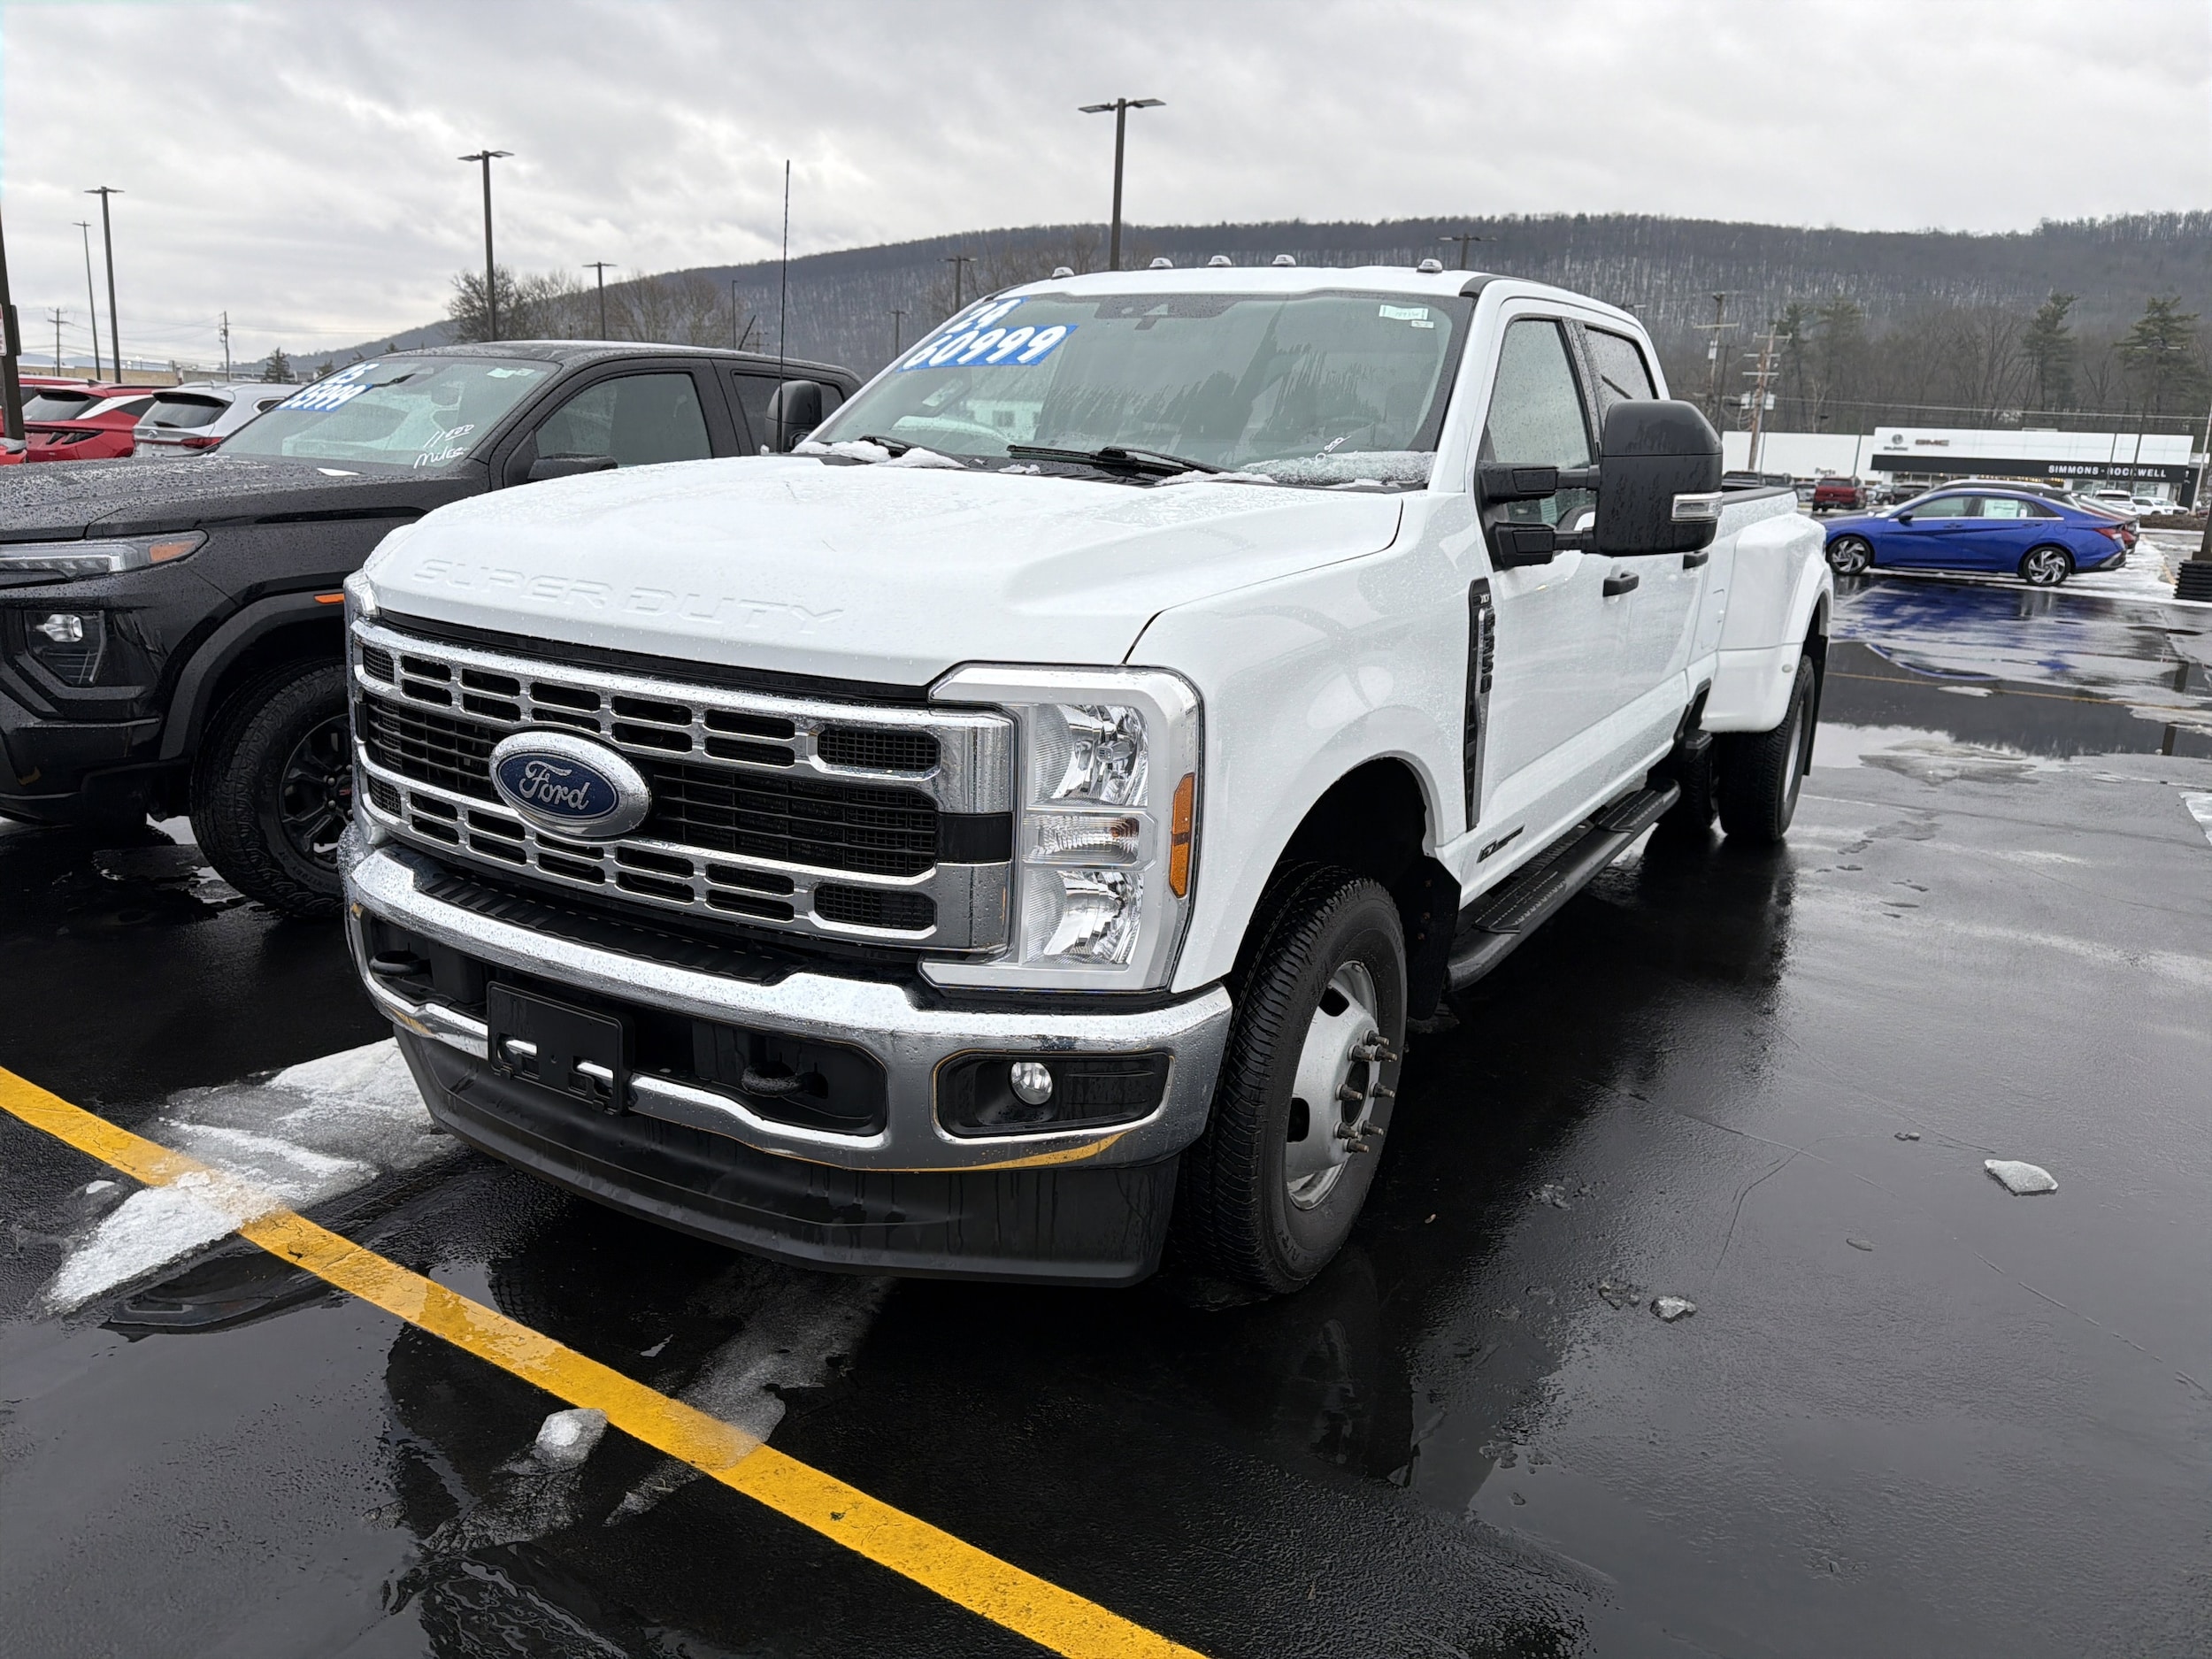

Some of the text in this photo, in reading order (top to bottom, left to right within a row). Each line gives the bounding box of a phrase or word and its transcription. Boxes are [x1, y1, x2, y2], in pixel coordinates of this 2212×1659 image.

[902, 325, 1067, 371] 60999
[411, 558, 845, 634] SUPER DUTY
[518, 760, 591, 810] Ford
